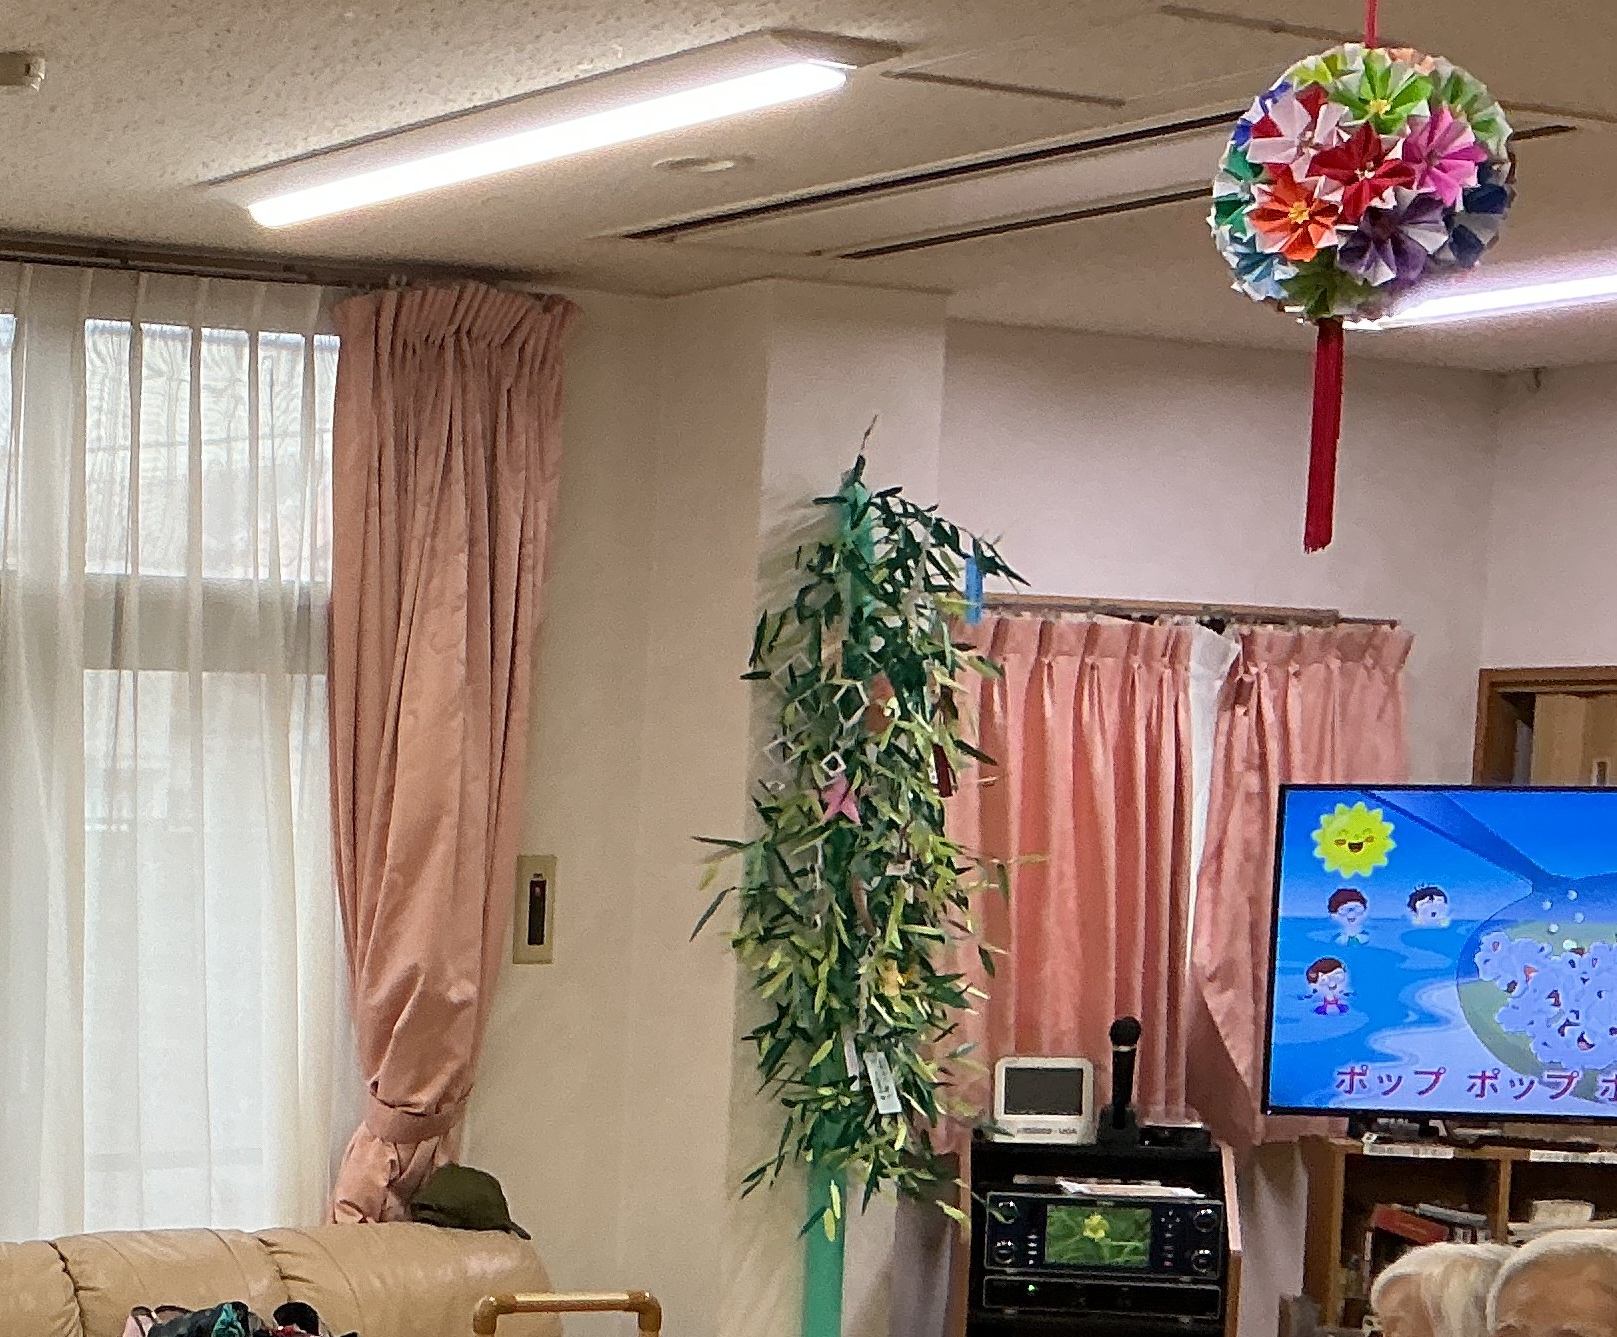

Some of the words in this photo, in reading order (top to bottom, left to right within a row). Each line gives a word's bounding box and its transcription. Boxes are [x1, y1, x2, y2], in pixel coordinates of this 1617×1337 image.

[1335, 1064, 1447, 1097] ポップ
[1466, 1066, 1581, 1100] ポップ
